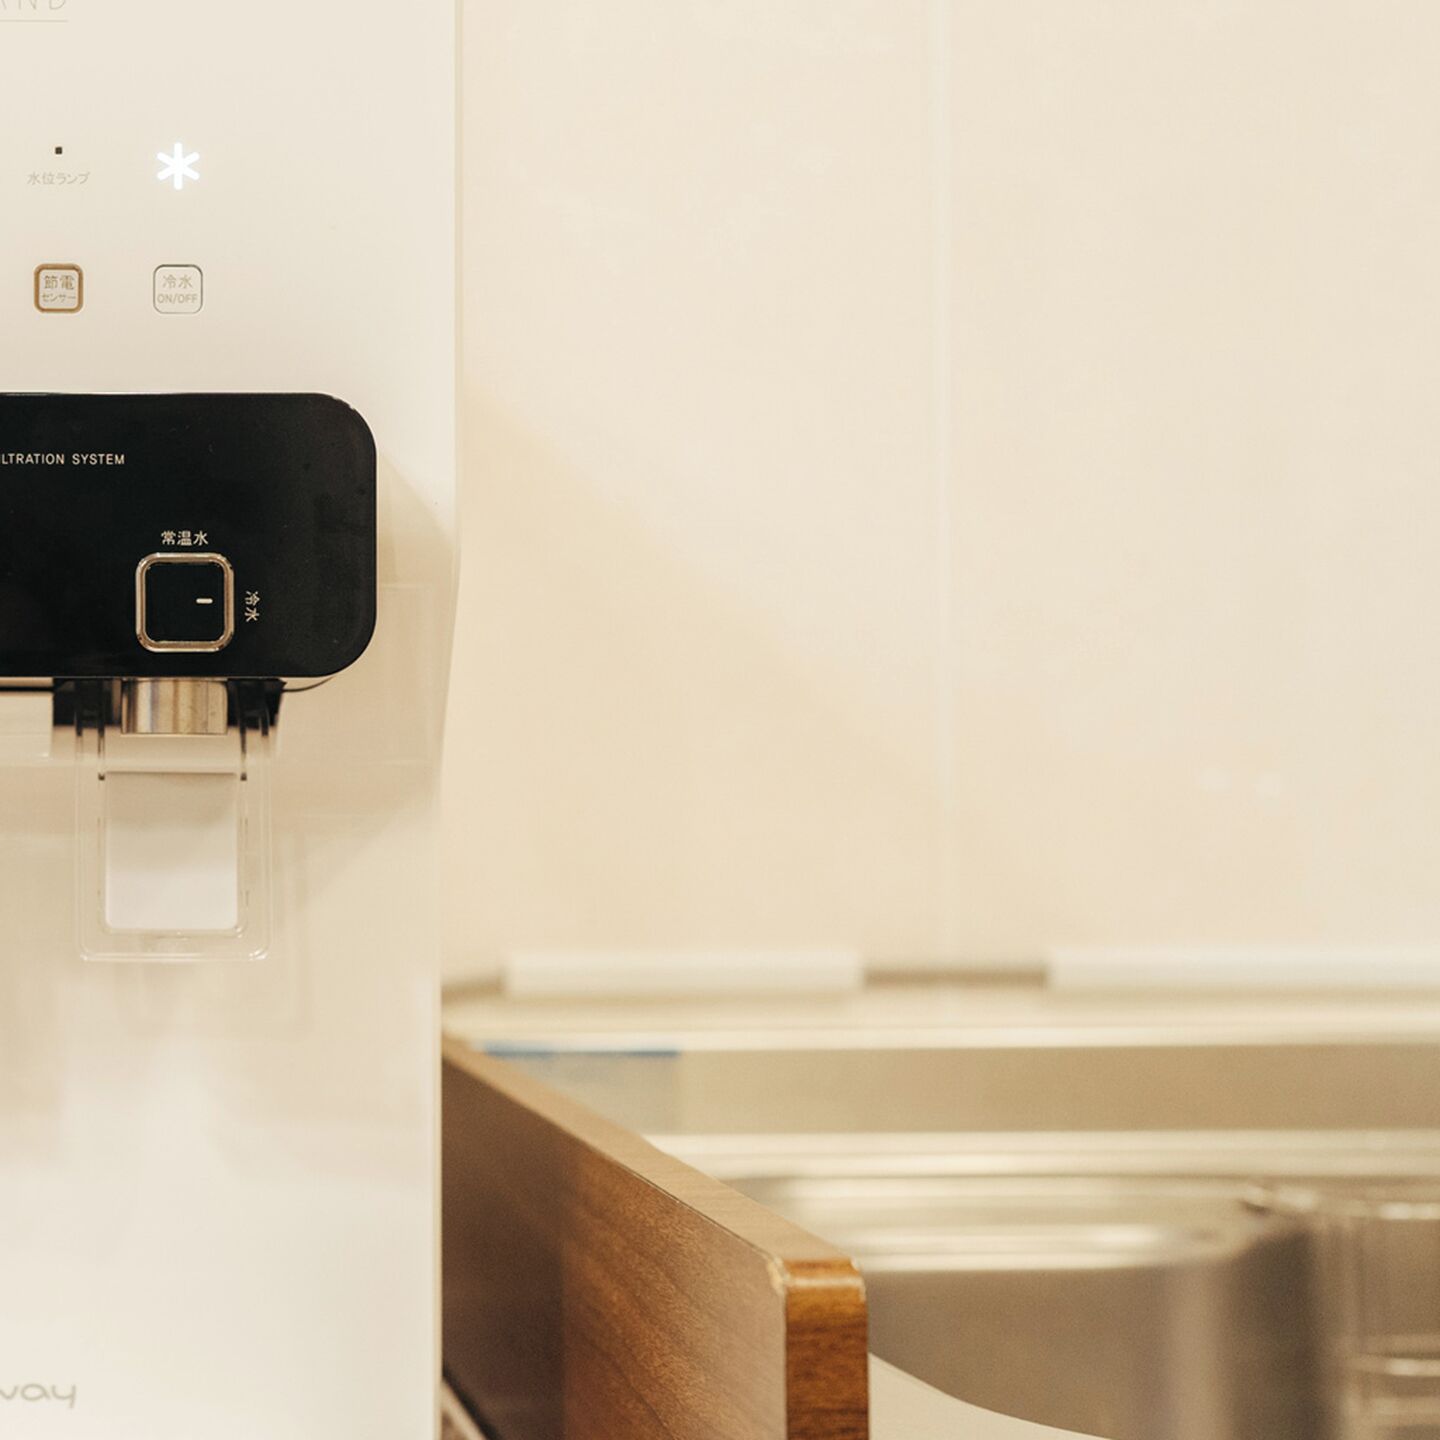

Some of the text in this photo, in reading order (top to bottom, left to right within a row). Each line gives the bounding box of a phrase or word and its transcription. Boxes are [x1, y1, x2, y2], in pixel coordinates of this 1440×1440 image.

[27, 171, 91, 185] 水位ランプ
[44, 275, 75, 290] 節電
[162, 274, 193, 289] 冷水
[42, 293, 76, 303] センサー
[157, 294, 198, 304] ON/OFF
[72, 454, 124, 465] SYSTEM
[160, 530, 209, 546] 常温水
[244, 590, 260, 622] 冷水
